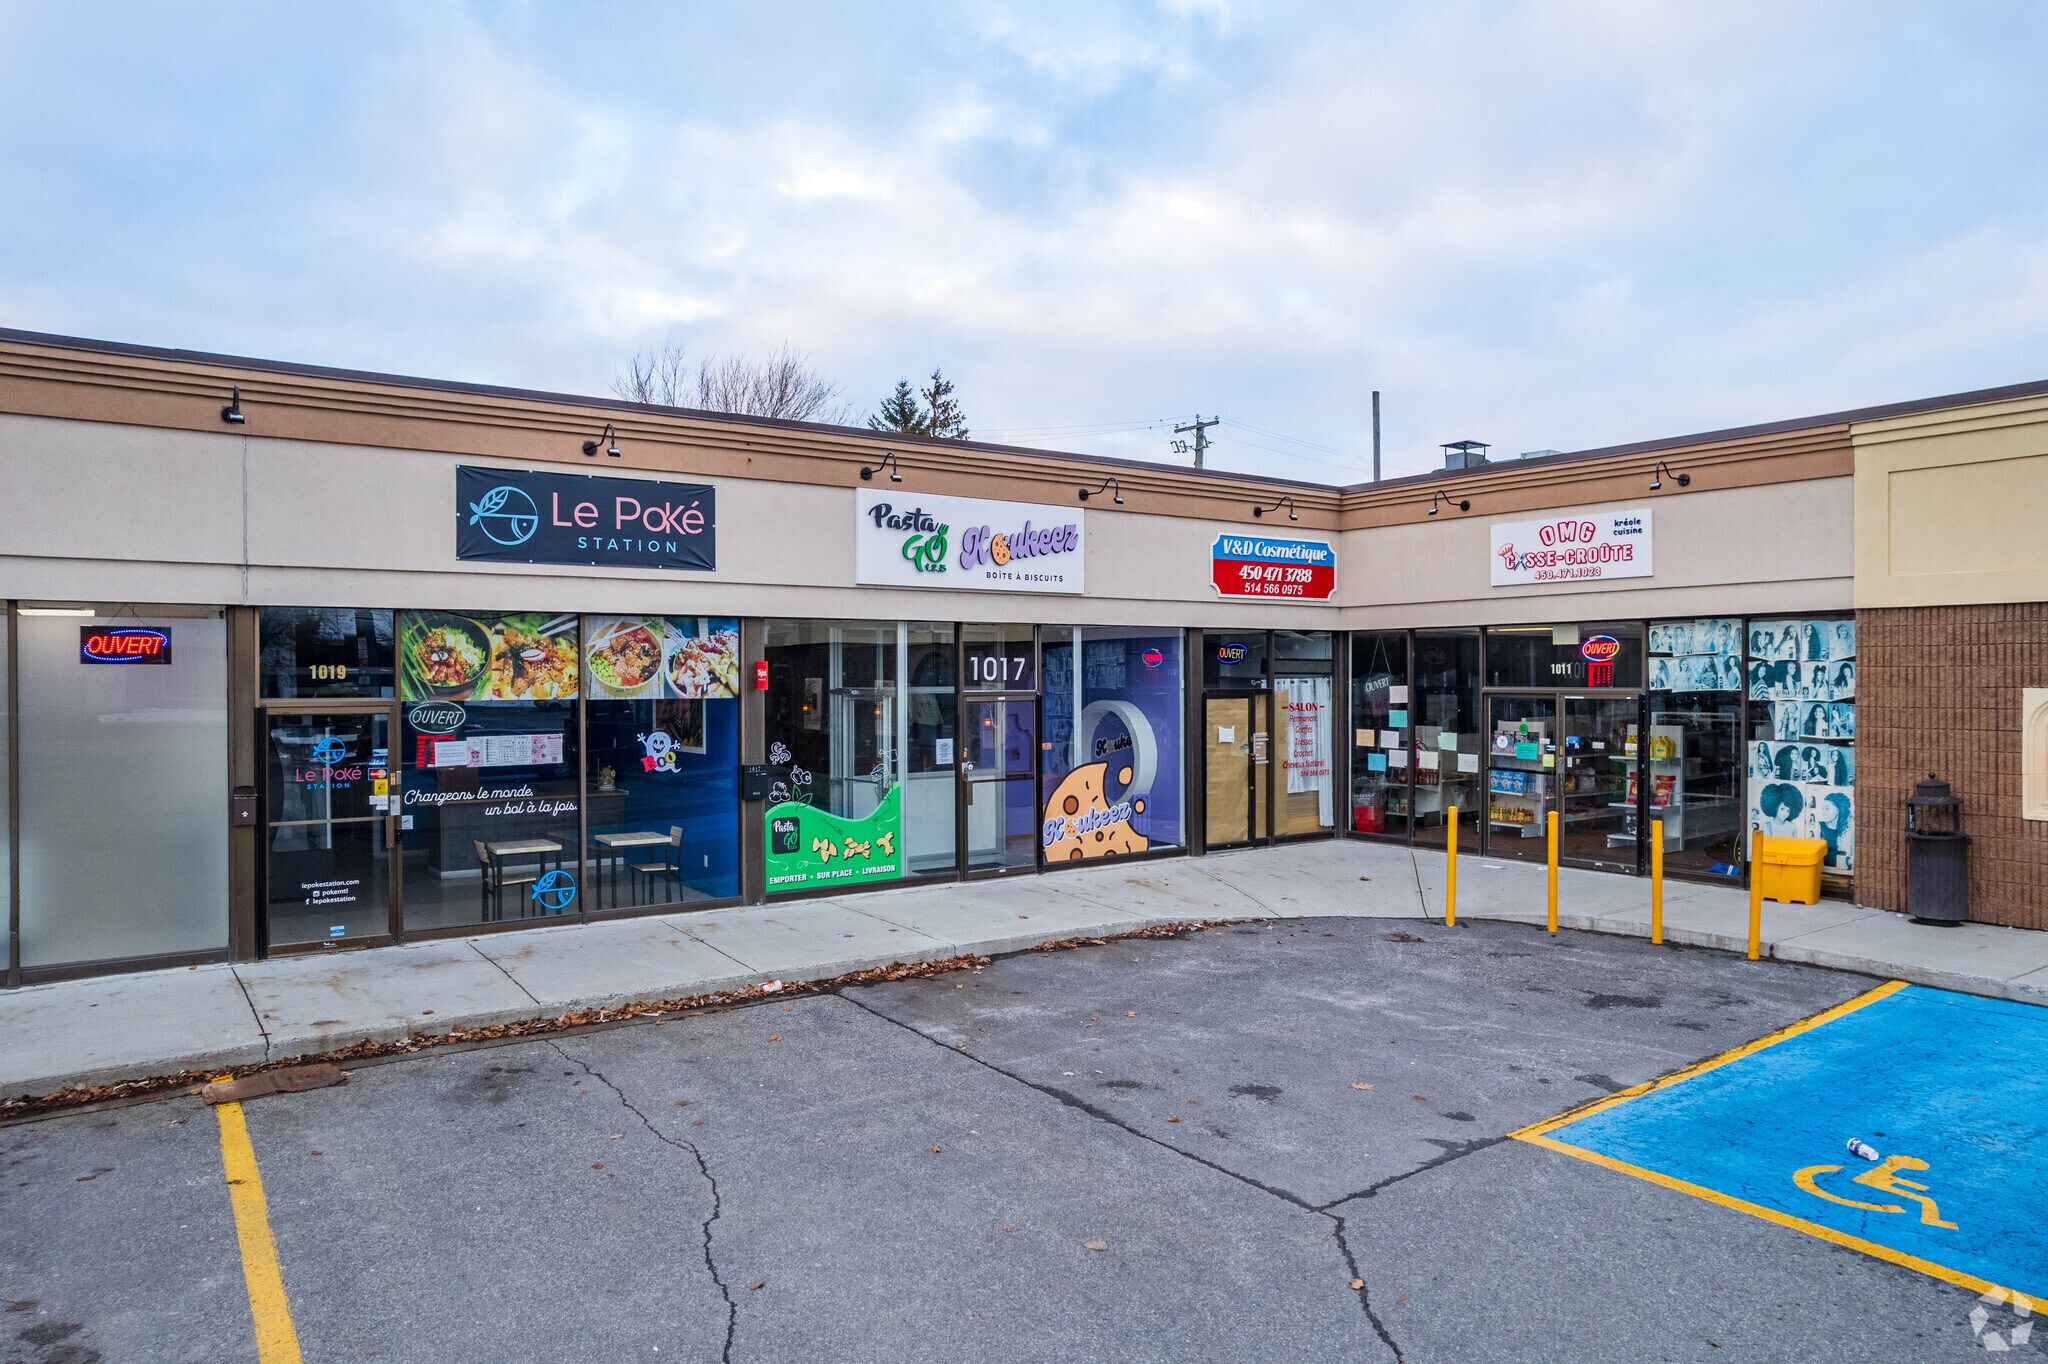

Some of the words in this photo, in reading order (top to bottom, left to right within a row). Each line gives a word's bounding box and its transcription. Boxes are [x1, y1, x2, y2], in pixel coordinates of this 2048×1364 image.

[552, 492, 599, 528] Le
[615, 496, 705, 535] Poké
[868, 503, 939, 533] Pasta
[1614, 517, 1642, 527] kréole
[1539, 521, 1596, 547] OMG
[1613, 527, 1643, 536] cuisine
[577, 536, 677, 553] STATION
[1223, 539, 1253, 556] V&D
[1254, 542, 1328, 564] Cosmétique
[902, 534, 948, 573] GO
[1016, 571, 1022, 580] À
[1024, 573, 1064, 582] BISCUITS
[1239, 565, 1262, 580] 450
[1263, 566, 1282, 582] 471
[1284, 568, 1313, 583] 3788
[1534, 566, 1602, 580] 450.471.1023
[1244, 582, 1261, 593] 514
[1263, 584, 1280, 594] 566
[1281, 584, 1303, 595] 0975
[88, 635, 164, 654] OUVERT
[1584, 642, 1617, 655] OUVERT
[1219, 647, 1245, 660] OUVERT
[309, 664, 347, 680] 1019
[970, 656, 1026, 681] 1017
[1550, 663, 1571, 675] 1011
[1365, 677, 1390, 693] OUVERT
[1289, 702, 1318, 712] SALON
[411, 710, 462, 725] OUVERT
[1289, 714, 1318, 723] Permanent
[1295, 738, 1313, 746] Tresses
[1293, 749, 1314, 758] Crochet
[641, 751, 677, 773] BOO
[295, 768, 316, 782] Le
[322, 765, 362, 781] Poké
[306, 782, 350, 790] STATION
[404, 789, 475, 806] Changeons
[476, 786, 490, 800] le
[485, 806, 502, 816] un
[503, 801, 524, 815] bol
[526, 801, 537, 813] à
[538, 800, 552, 813] la
[772, 819, 795, 833] Pasta
[783, 832, 798, 851] GO
[769, 873, 807, 885] EMPORTER
[816, 871, 831, 880] SUR
[832, 869, 853, 878] PLACE
[862, 864, 896, 875] LIVRAISON
[301, 879, 360, 890] lepokestation.com
[322, 888, 349, 897] pokemtl
[312, 896, 356, 905] lepokestation
